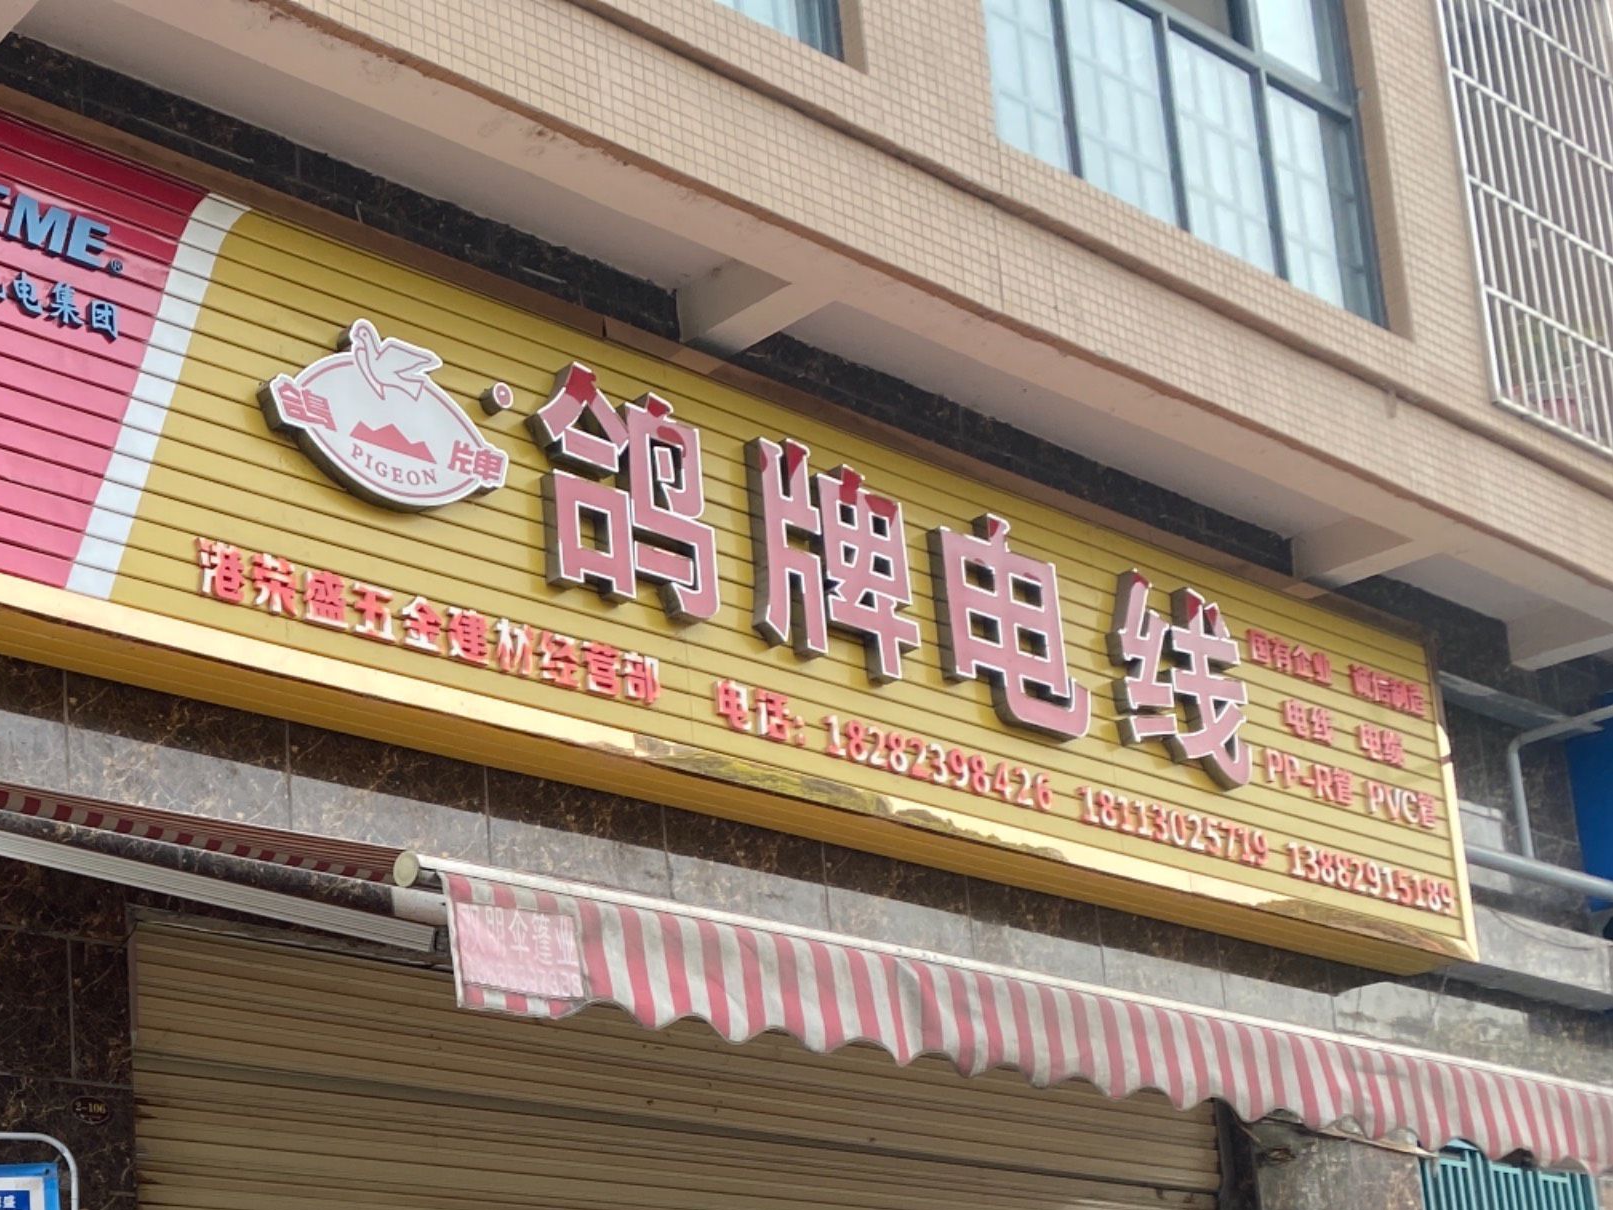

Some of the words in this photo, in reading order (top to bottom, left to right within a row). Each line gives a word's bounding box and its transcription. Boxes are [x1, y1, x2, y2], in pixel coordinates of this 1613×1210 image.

[351, 442, 438, 486] PIGEON
[526, 361, 1252, 792] 鸽牌电线
[194, 536, 662, 706] 港荣盛五金建材经营部
[1246, 628, 1332, 688] 国有企业
[1281, 699, 1333, 746] 电线
[1356, 723, 1404, 767] 电缆
[822, 714, 1054, 813] 18282398426
[1077, 785, 1270, 867] 18113025719
[1287, 841, 1458, 915] 13882915189
[1263, 747, 1353, 807] PP-R管
[1365, 780, 1437, 829] PVC管
